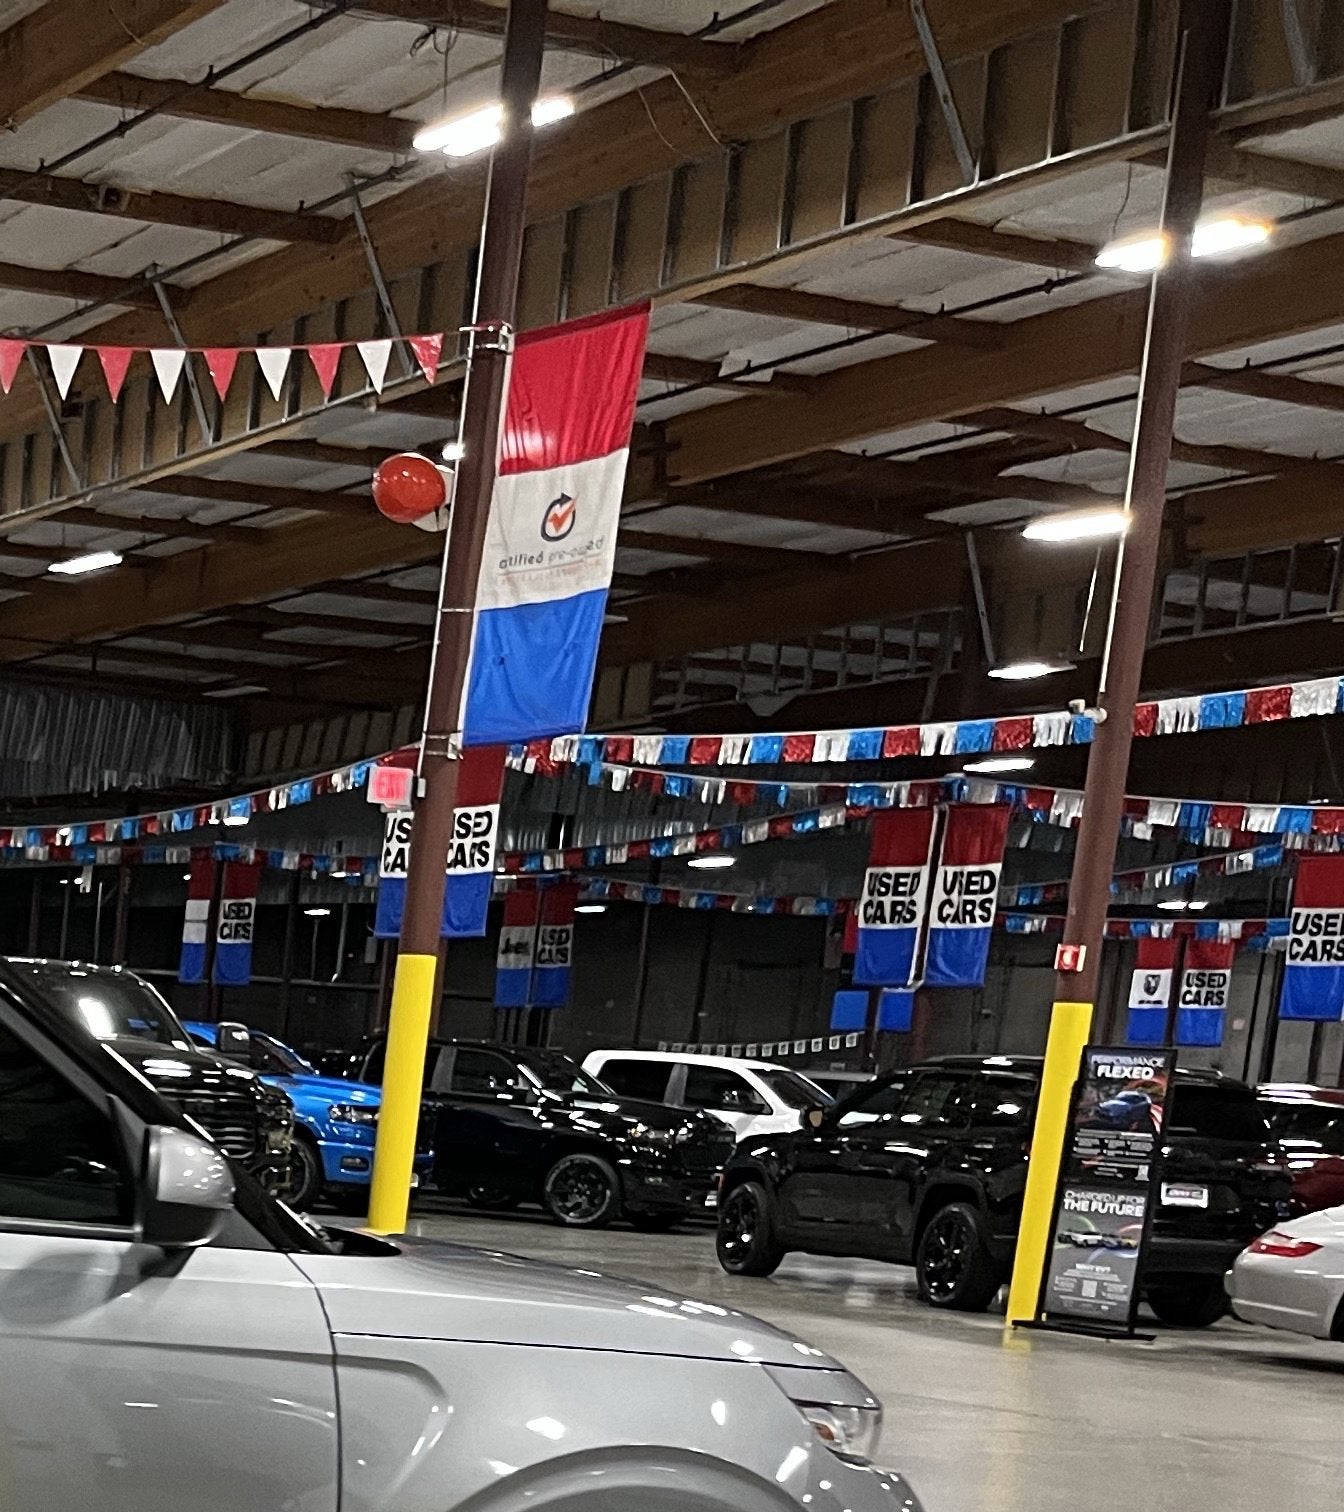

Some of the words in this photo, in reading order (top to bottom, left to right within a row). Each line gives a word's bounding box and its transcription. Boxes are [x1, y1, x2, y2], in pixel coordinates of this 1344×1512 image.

[385, 817, 412, 844] US
[384, 847, 407, 872] CA
[867, 871, 921, 897] USED
[863, 899, 917, 924] CARS
[1292, 912, 1344, 937] USE
[1186, 972, 1226, 988] USED
[1181, 990, 1224, 1006] CARS
[1097, 1064, 1155, 1081] FLEXED
[1064, 1198, 1090, 1212] THE
[1090, 1201, 1145, 1218] FUTURE
